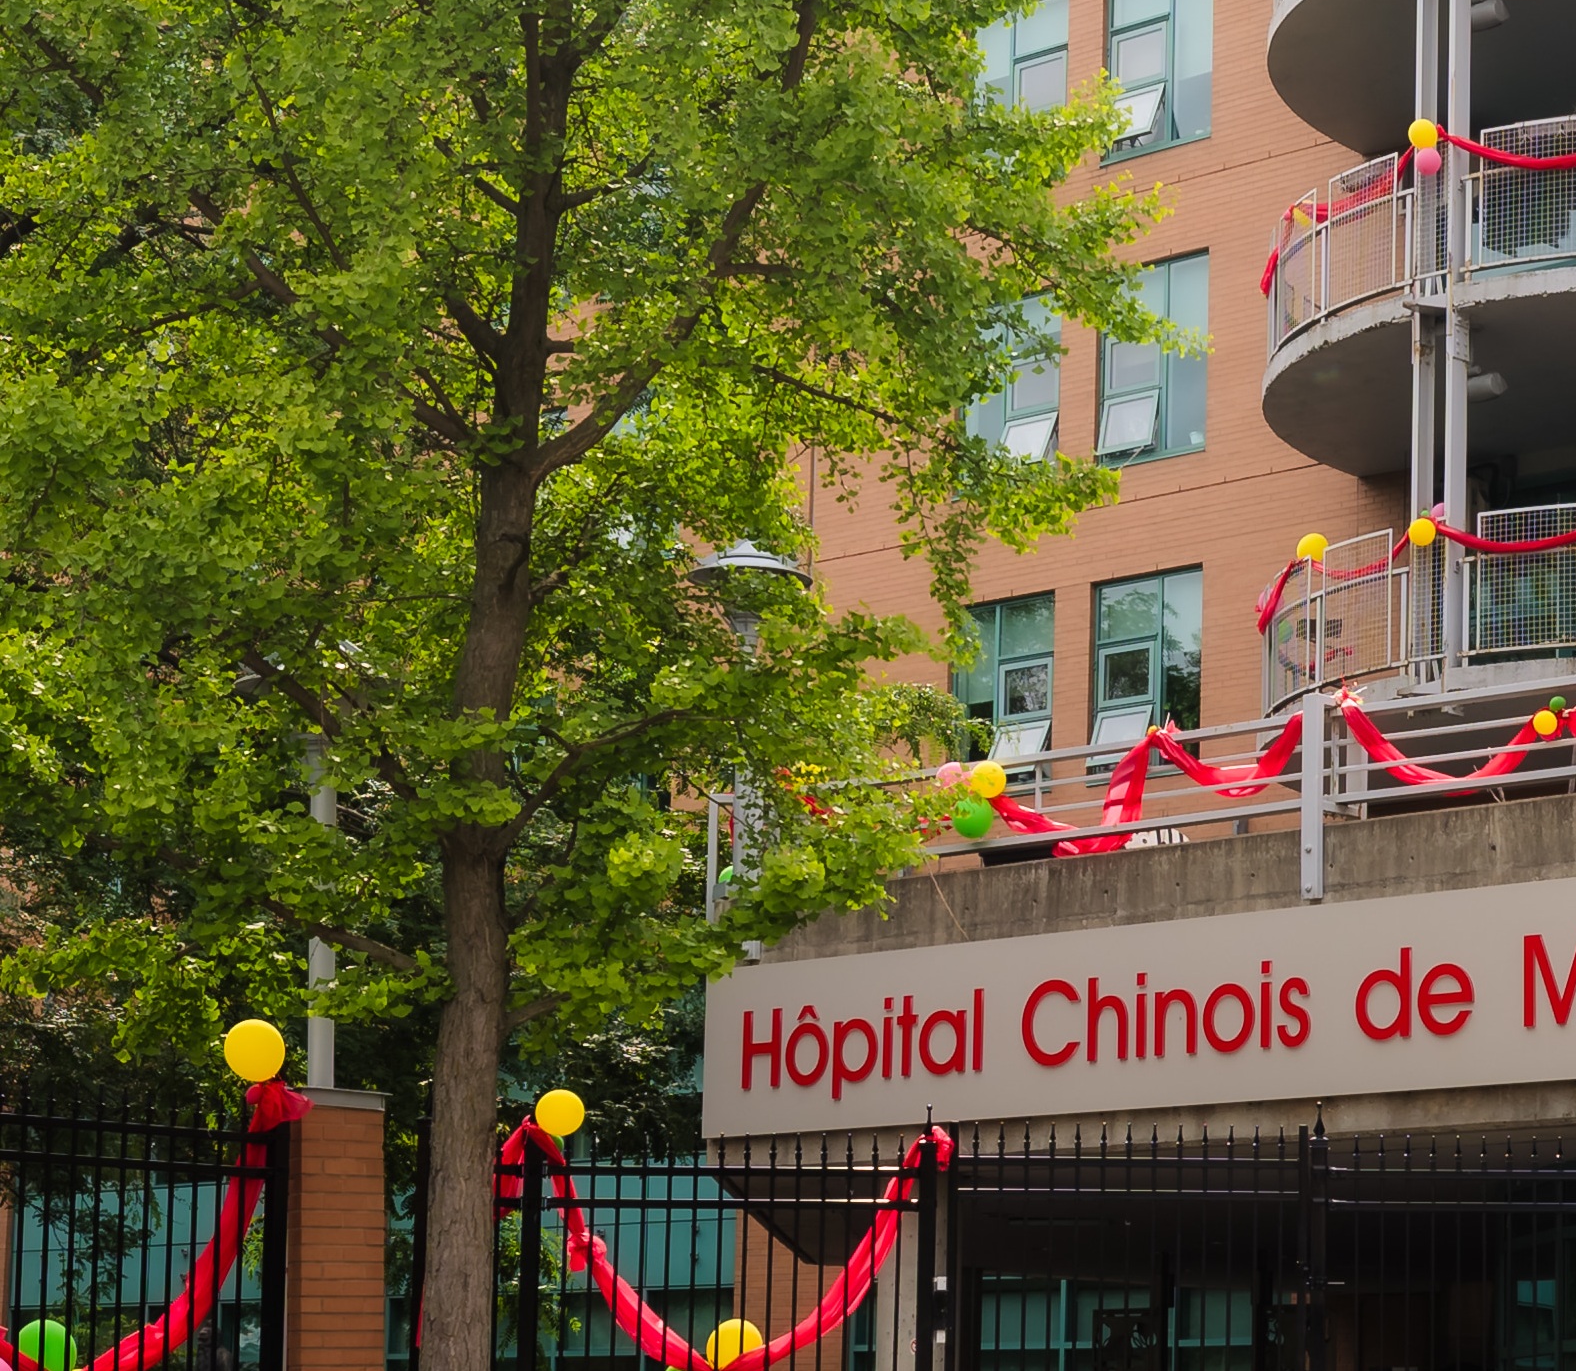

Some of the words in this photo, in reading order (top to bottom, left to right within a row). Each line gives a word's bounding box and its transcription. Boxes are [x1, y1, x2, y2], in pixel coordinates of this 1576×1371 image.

[741, 988, 985, 1101] Hôpital
[1021, 960, 1312, 1069] Chinois
[1354, 946, 1475, 1042] de
